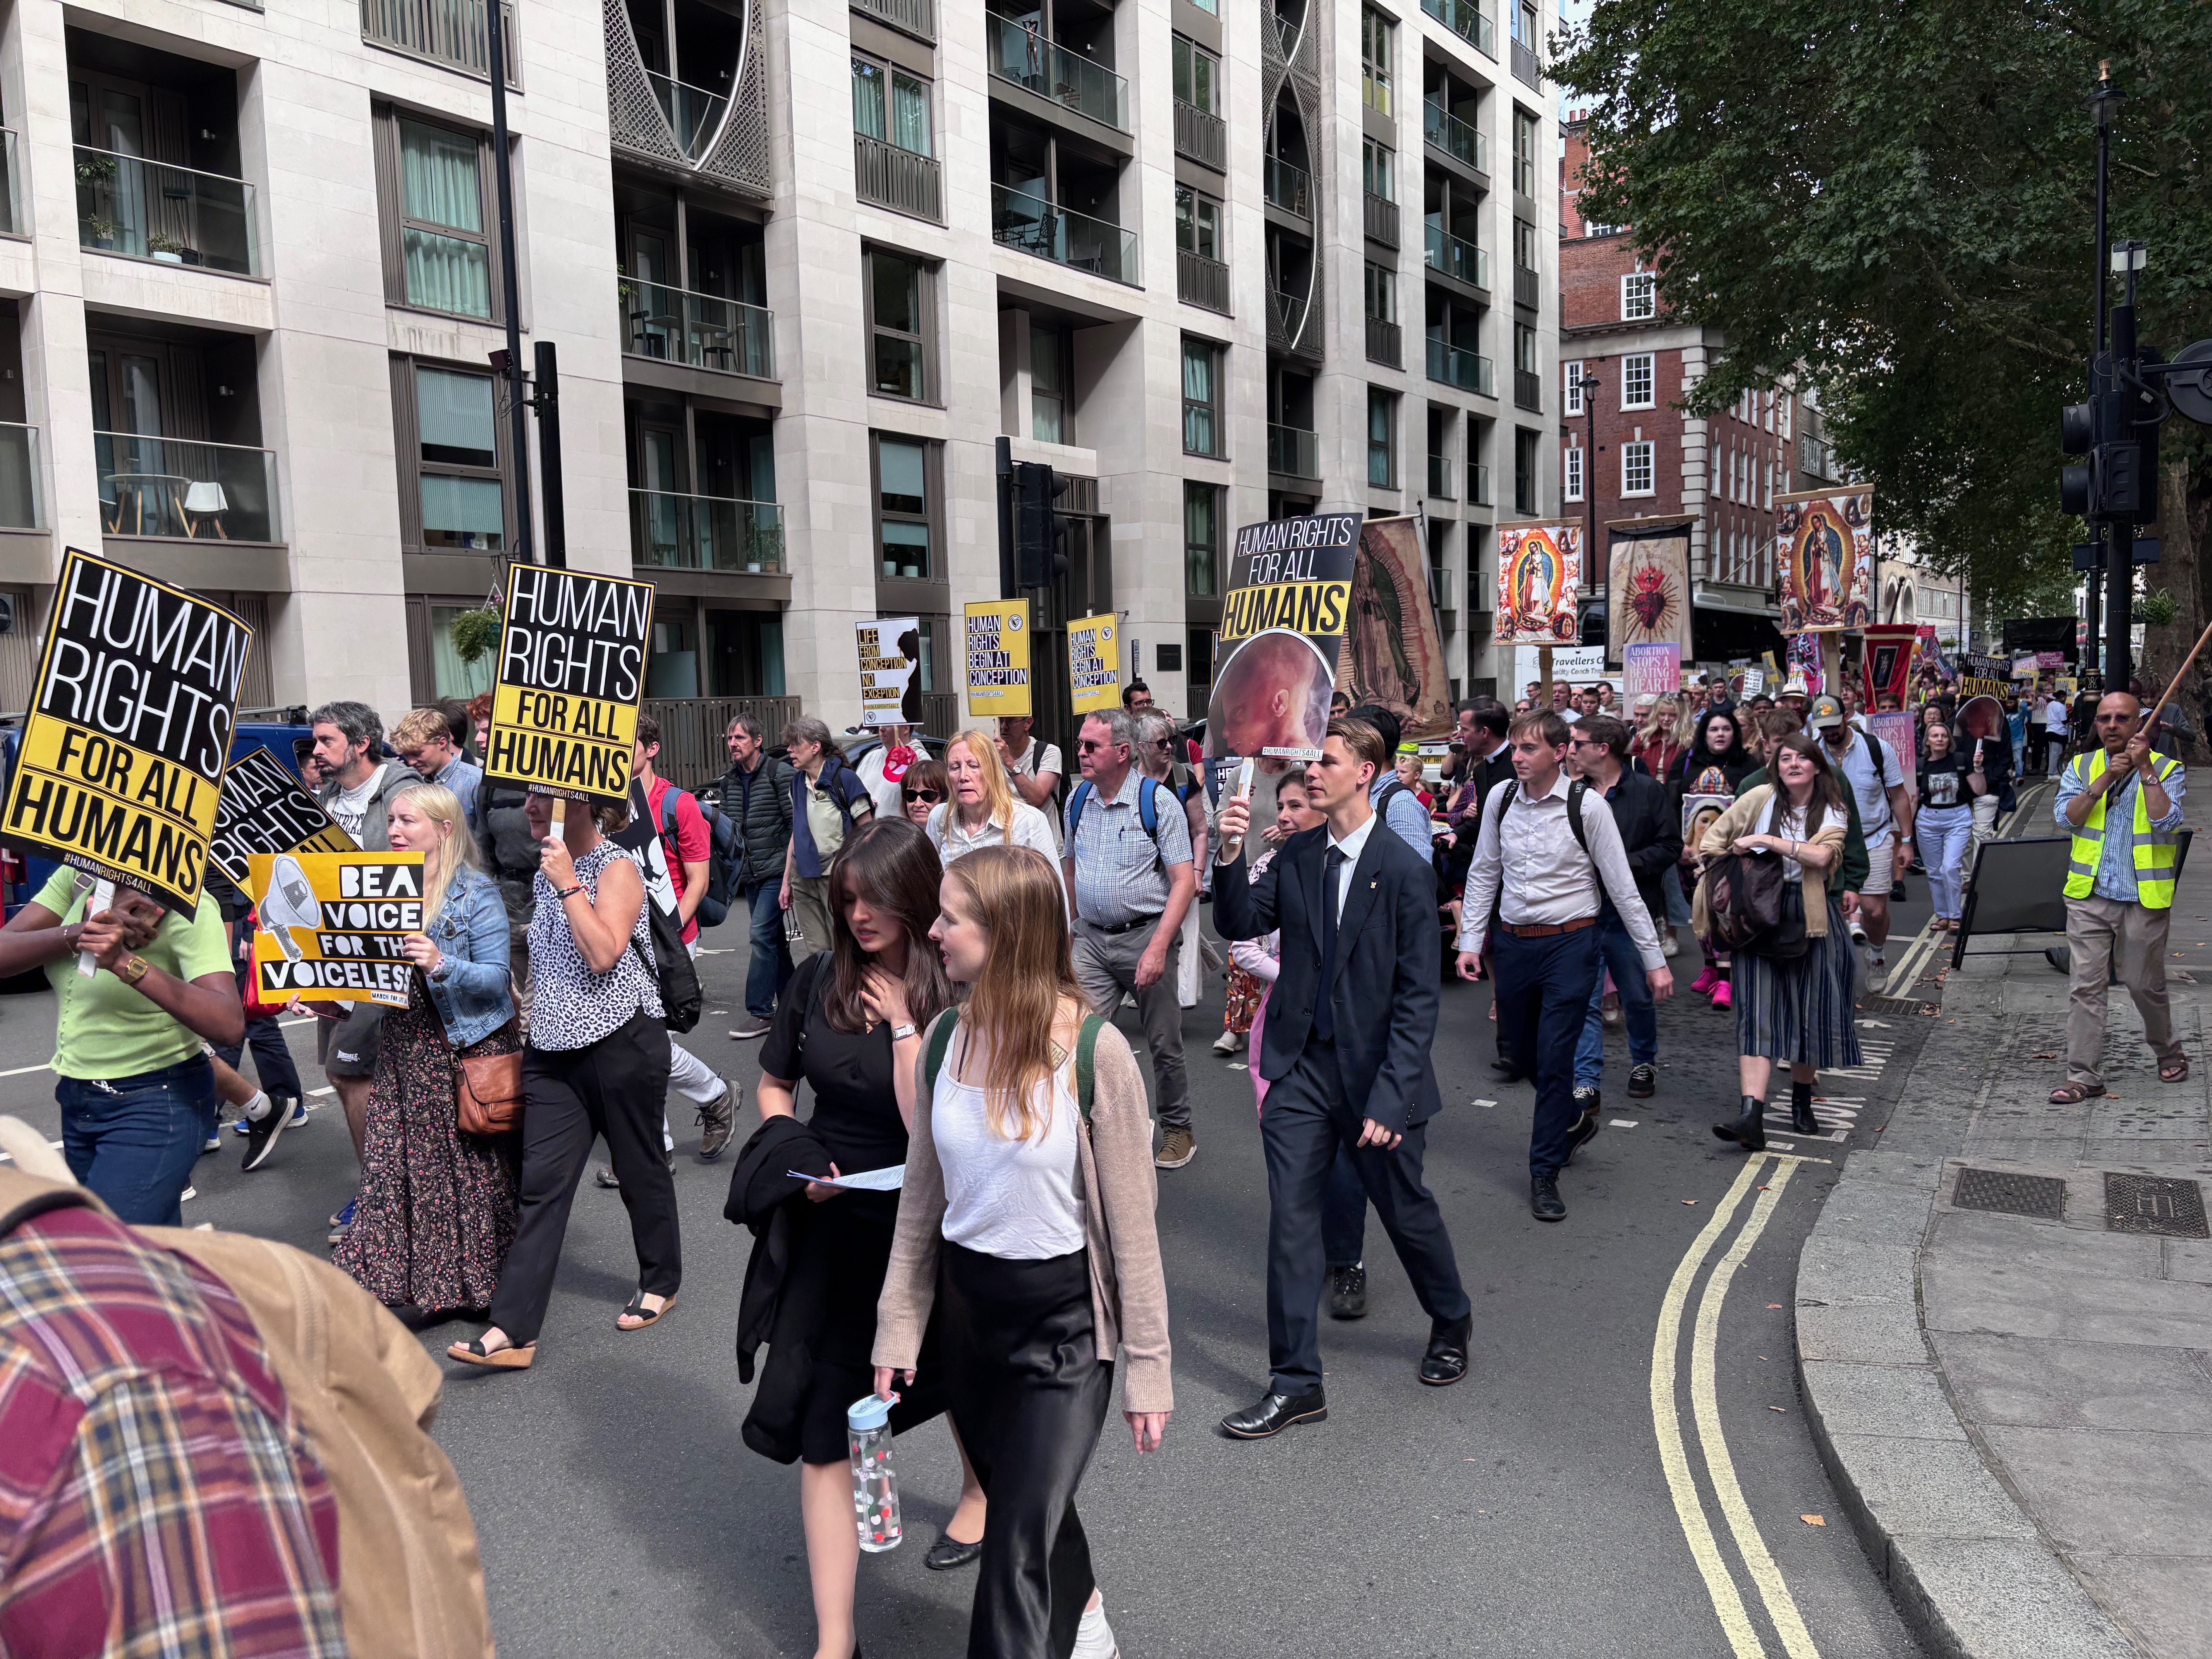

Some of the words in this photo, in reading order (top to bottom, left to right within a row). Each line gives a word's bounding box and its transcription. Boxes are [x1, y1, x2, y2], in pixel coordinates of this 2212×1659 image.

[1238, 528, 1291, 557] HUMAN
[1291, 517, 1354, 549] RIGHTS
[1248, 553, 1281, 585] FOR
[1283, 548, 1317, 581] ALL
[510, 568, 649, 641] HUMAN
[1221, 584, 1345, 639] HUMANS
[61, 560, 249, 703] HUMAN
[967, 615, 1001, 633] HUMAN
[857, 629, 879, 644] LIFE
[968, 634, 1000, 651] RIGHTS
[1070, 629, 1096, 646] HUMAN
[859, 645, 880, 658] FROM
[969, 651, 993, 668] BEGIN
[996, 651, 1010, 667] AT
[1071, 644, 1096, 660] RIGHTS
[1630, 646, 1669, 656] ABORTION
[503, 626, 641, 701] RIGHTS
[860, 657, 907, 671] CONCEPTION
[1072, 659, 1091, 675] BEGIN
[1092, 658, 1103, 672] AT
[1552, 656, 1594, 666] Travellers
[1630, 656, 1661, 667] STOPS
[1663, 656, 1669, 668] A
[1968, 655, 1990, 668] HUMAN
[1990, 658, 2010, 672] RIGHTS
[862, 673, 874, 687] NO
[969, 668, 1027, 686] CONCEPTION
[1073, 670, 1117, 689] CONCEPTION
[1630, 667, 1669, 678] BEATING
[1975, 667, 1988, 679] FOR
[1988, 669, 1999, 681] ALL
[863, 687, 900, 699] EXCEPTION
[1630, 678, 1670, 693] HEART
[1961, 677, 2008, 699] HUMANS
[42, 637, 230, 778] RIGHTS
[517, 690, 568, 732] FOR
[572, 702, 620, 740] ALL
[1872, 716, 1905, 728] ABORTION
[1872, 727, 1898, 740] STOPS
[1900, 726, 1906, 740] A
[1263, 747, 1321, 757] #HUMANRIGHTS4ALL
[491, 730, 629, 793] HUMANS
[56, 726, 134, 795] FOR
[137, 761, 198, 828] ALL
[528, 783, 590, 802] #HUMANRIGHTS4ALL
[10, 774, 204, 896] HUMANS
[210, 791, 326, 879] RIGHTS
[64, 852, 153, 895] #HUMANRIGHTS4ALL
[341, 866, 383, 898] BE
[386, 866, 418, 897] A
[324, 903, 421, 929] VOICE
[320, 935, 366, 956] FOR
[374, 936, 404, 957] TH
[262, 962, 411, 993] VOICELESS
